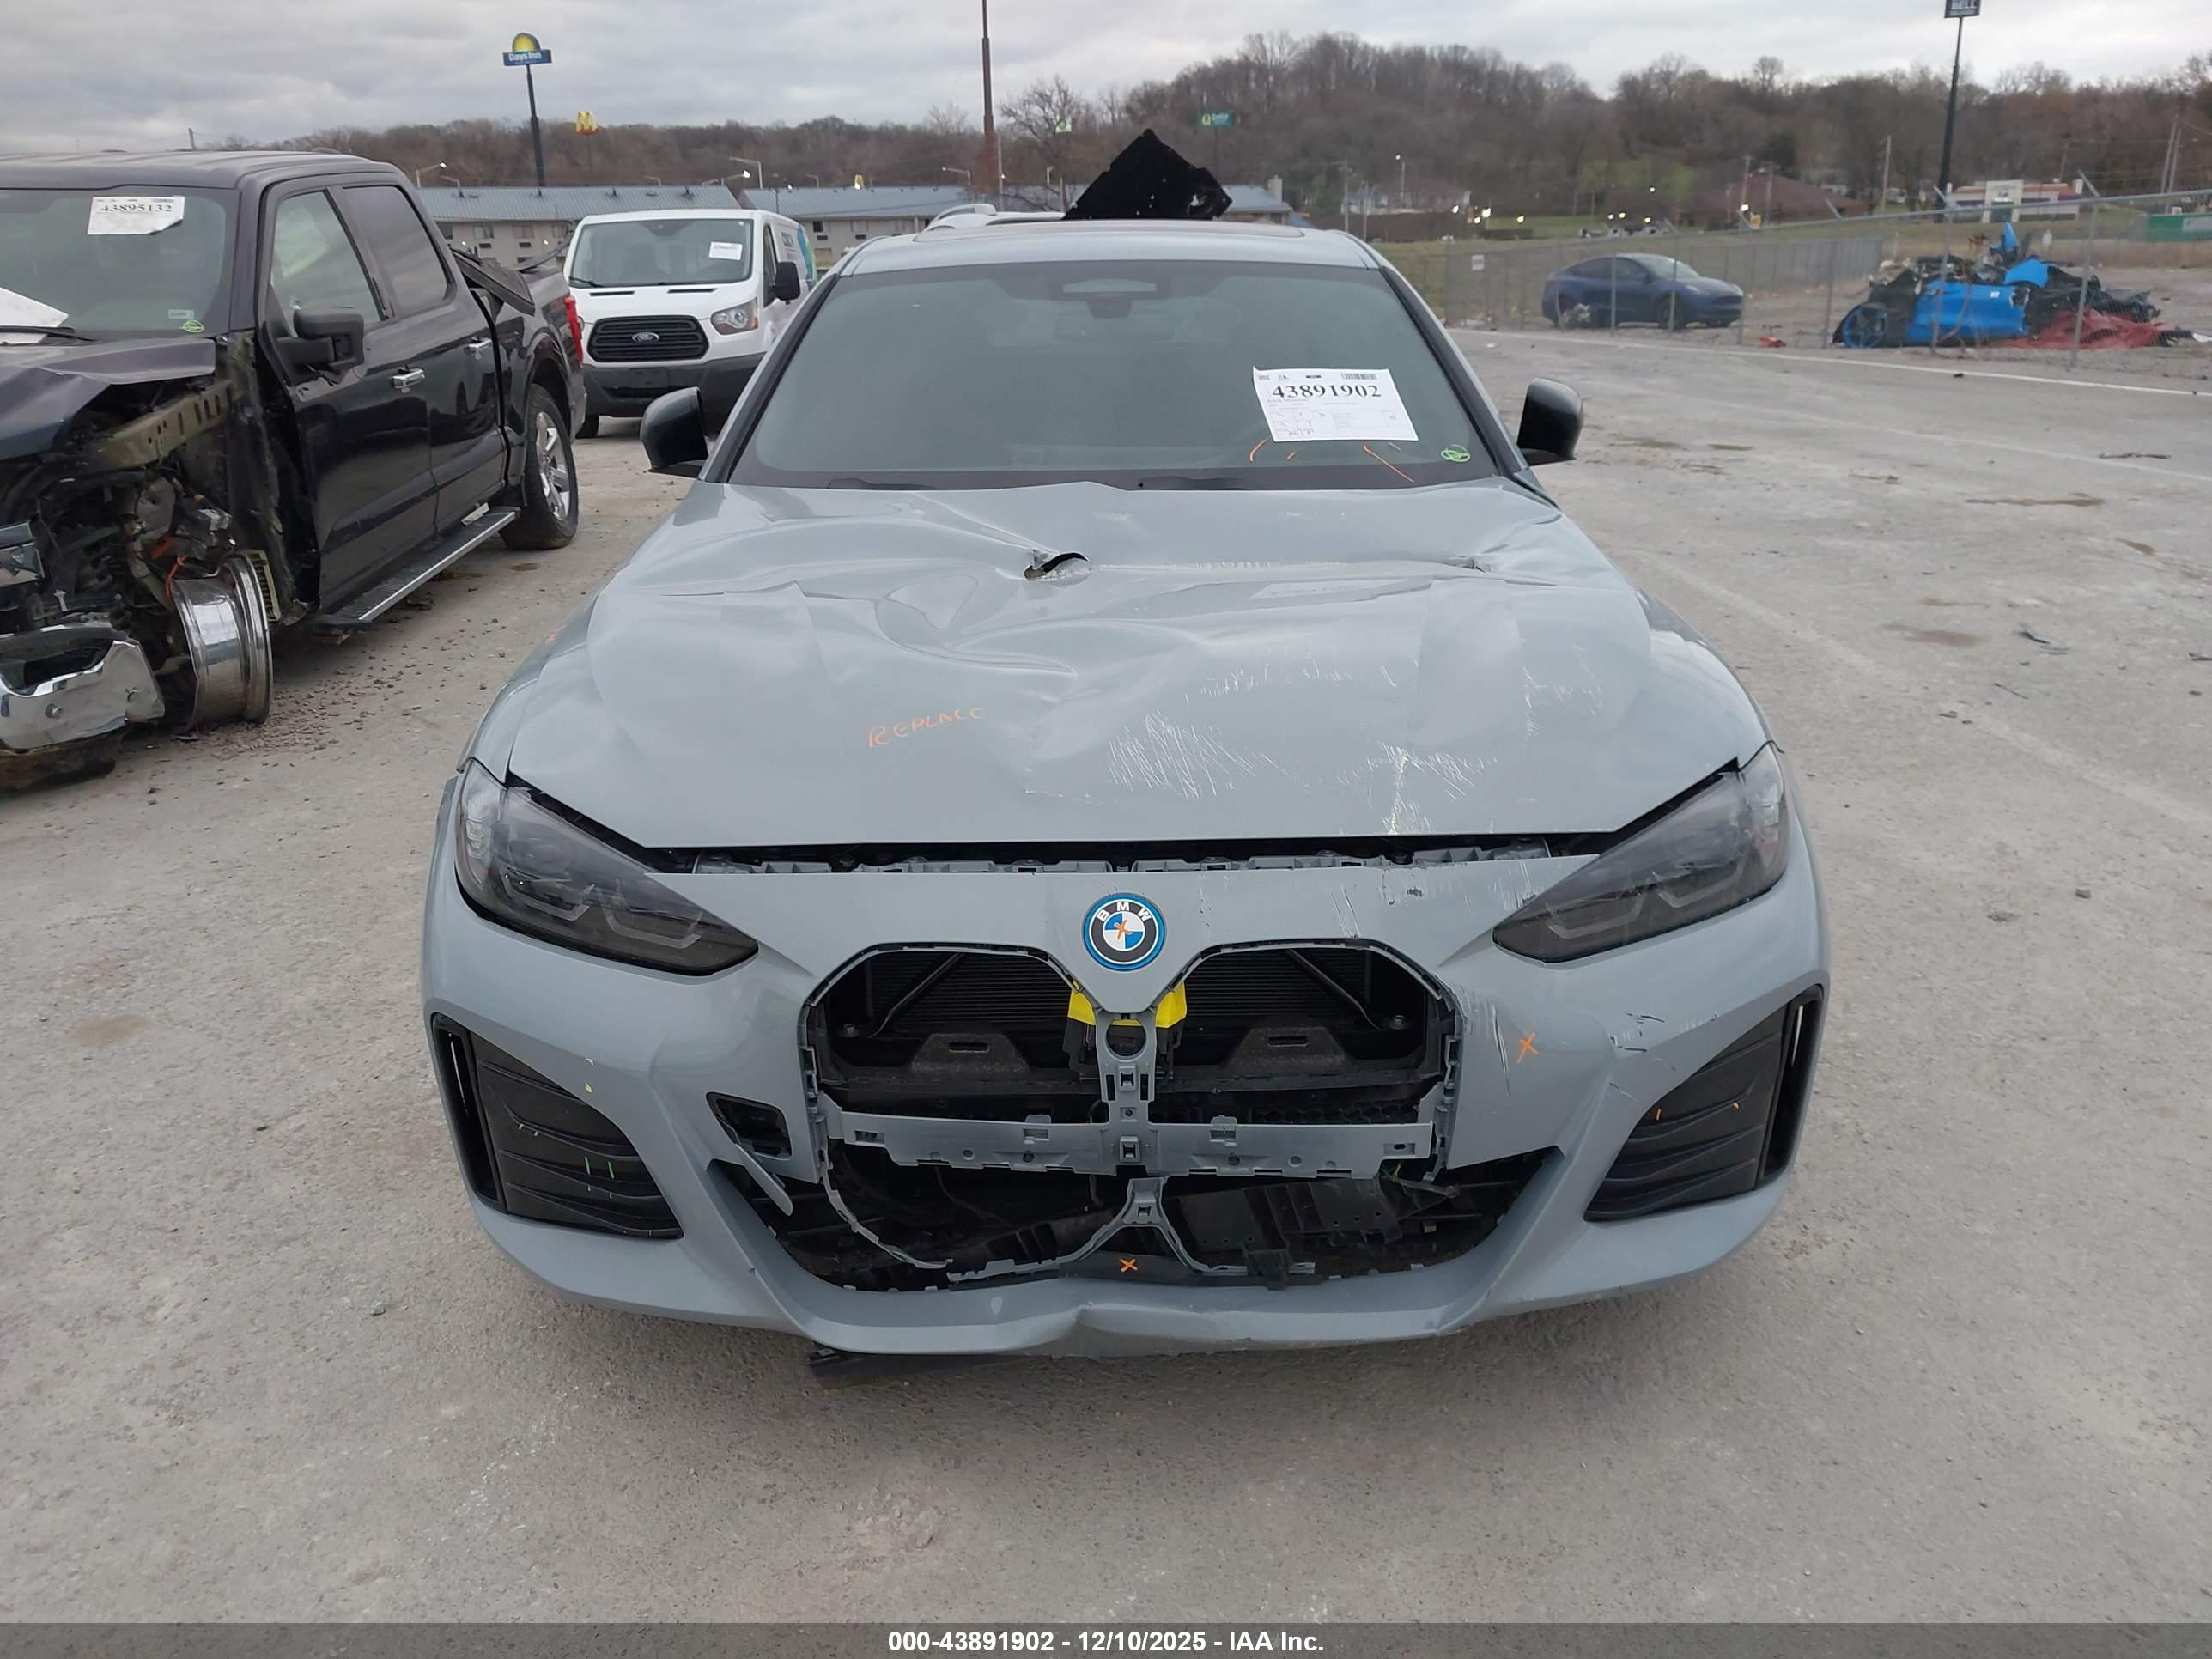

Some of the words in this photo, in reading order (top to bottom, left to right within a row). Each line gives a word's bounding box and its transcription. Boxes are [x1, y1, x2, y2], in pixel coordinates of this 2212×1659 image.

[508, 53, 527, 62] Days
[100, 204, 173, 212] 43895132
[1272, 383, 1382, 398] 43891902
[1096, 902, 1152, 922] BMW
